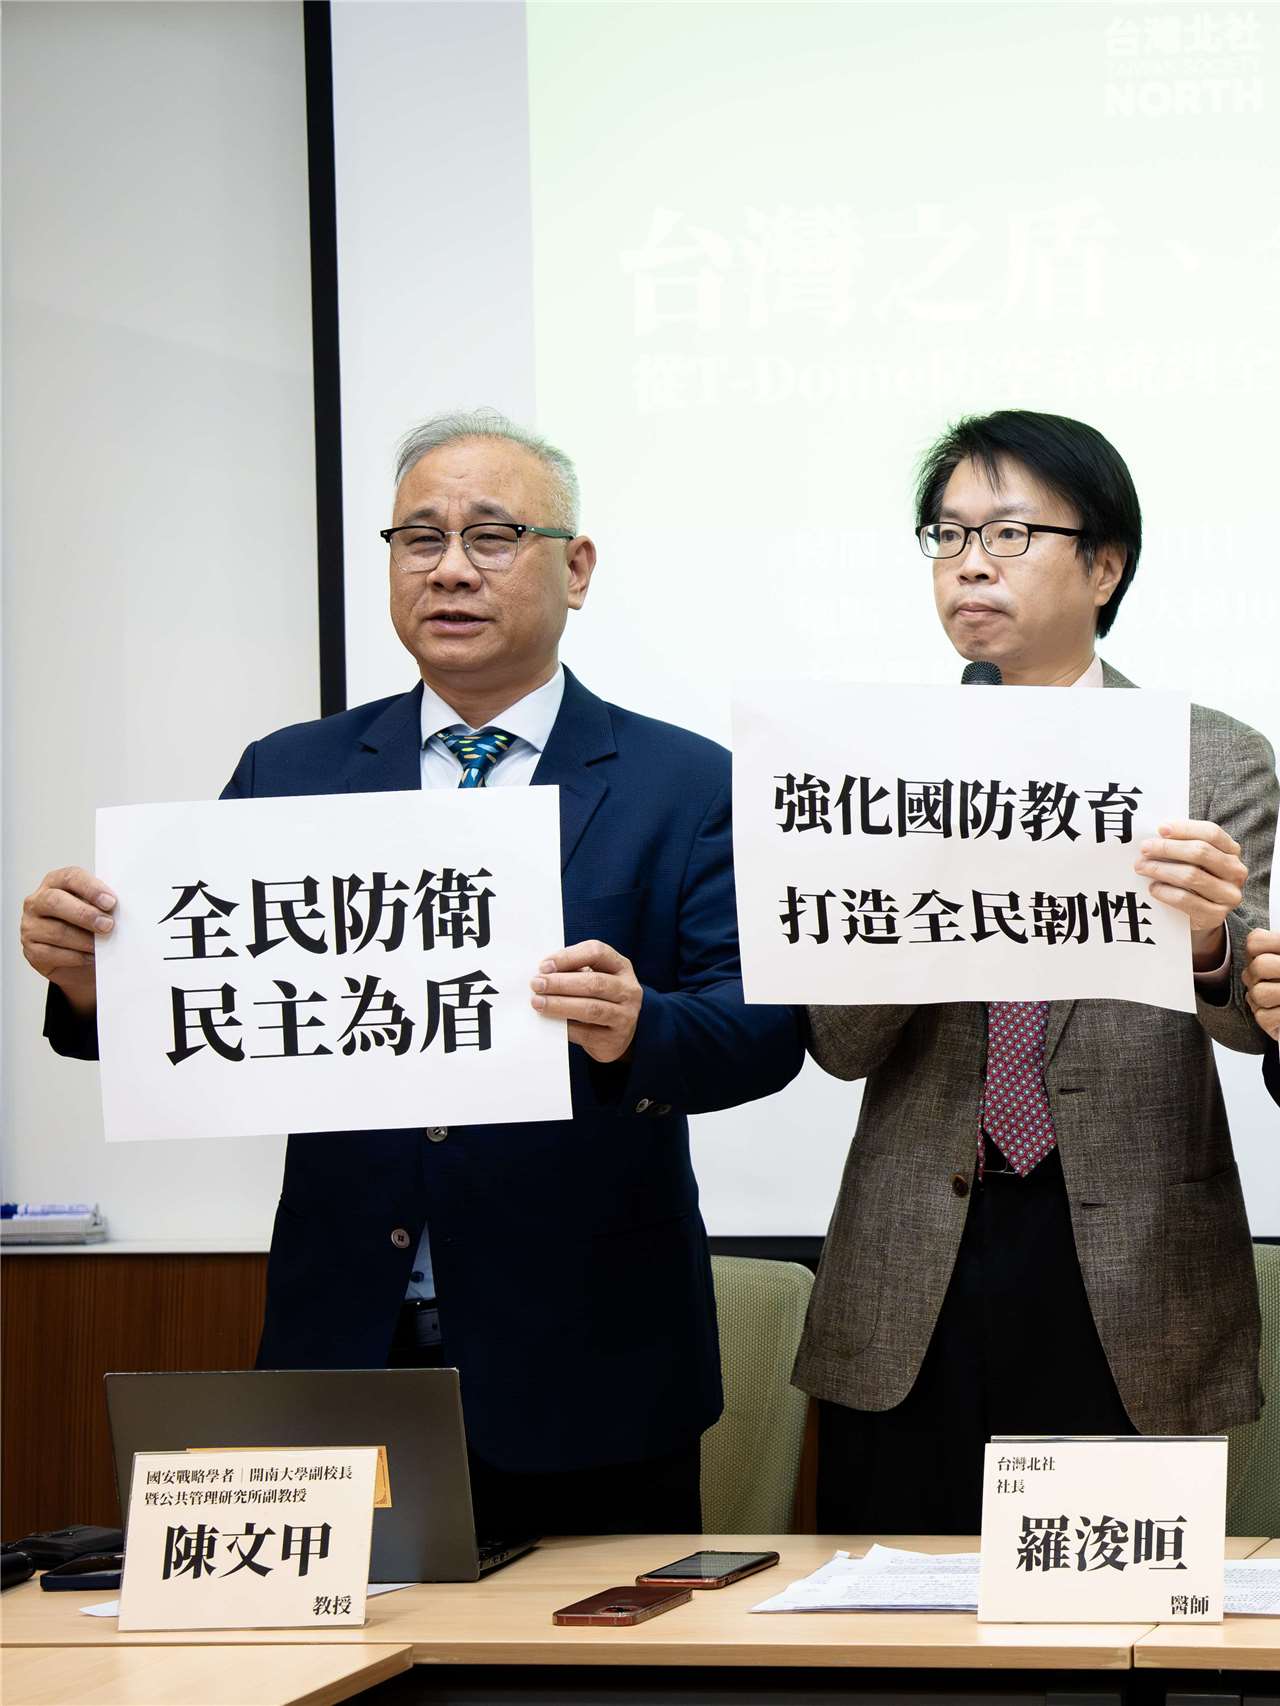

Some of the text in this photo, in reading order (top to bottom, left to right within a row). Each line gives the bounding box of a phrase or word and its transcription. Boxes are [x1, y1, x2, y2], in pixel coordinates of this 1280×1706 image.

[1104, 77, 1264, 119] NORTH
[774, 773, 1142, 844] 強化國防教育
[158, 868, 496, 960] 全民防衛
[779, 886, 1156, 945] 打造全民韌性
[166, 970, 499, 1066] 民主為盾
[998, 1457, 1054, 1471] 台灣北社
[998, 1480, 1024, 1493] 社長
[145, 1488, 306, 1505] 暨公共管理研究所副教授
[162, 1523, 332, 1580] 陳文甲
[1016, 1515, 1187, 1571] 羅浚晅
[313, 1596, 351, 1615] 教授
[1172, 1595, 1208, 1614] 醫師
